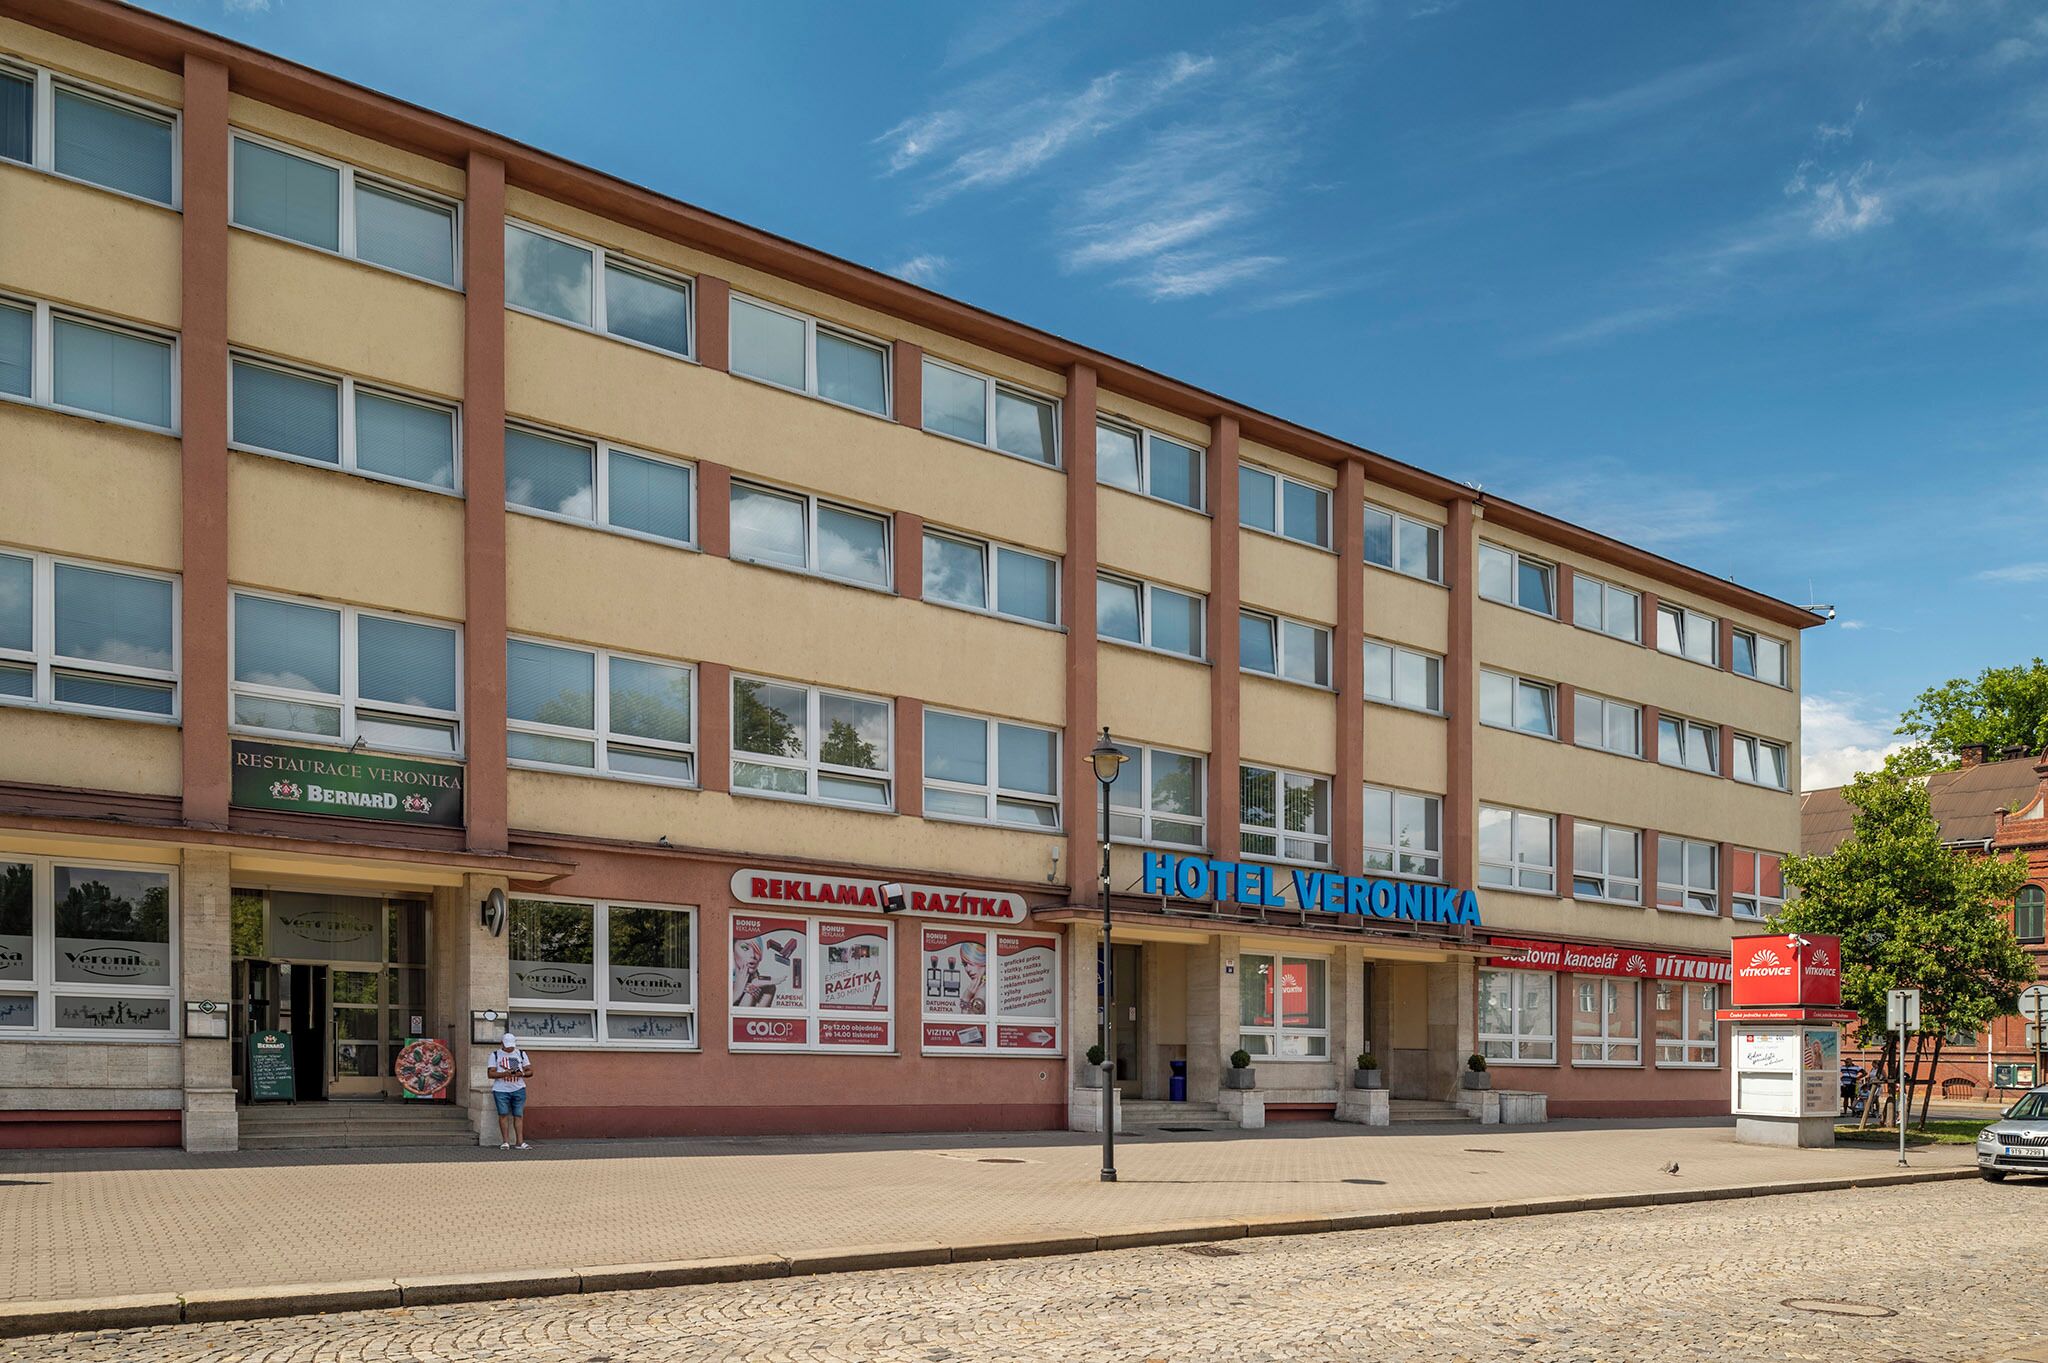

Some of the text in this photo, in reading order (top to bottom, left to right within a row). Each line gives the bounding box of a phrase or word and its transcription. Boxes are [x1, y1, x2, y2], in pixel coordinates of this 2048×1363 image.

[237, 752, 462, 789] RESTAURACE VERONIKA
[307, 784, 397, 810] BERNARD
[751, 877, 1014, 918] REKLAMA RAZÍTKA
[1142, 851, 1482, 926] HOTEL VERONIKA
[64, 952, 160, 967] Veronika
[1564, 950, 1619, 969] kancelář
[1655, 955, 1732, 981] VÍTKOVIC
[515, 972, 587, 985] Veronika
[1740, 965, 1792, 977] VÍTKOVICE
[1804, 965, 1836, 977] VÍTKOVICE
[616, 977, 682, 988] Veronika
[825, 970, 881, 995] RAZÍTKA
[746, 1021, 793, 1036] COLOP
